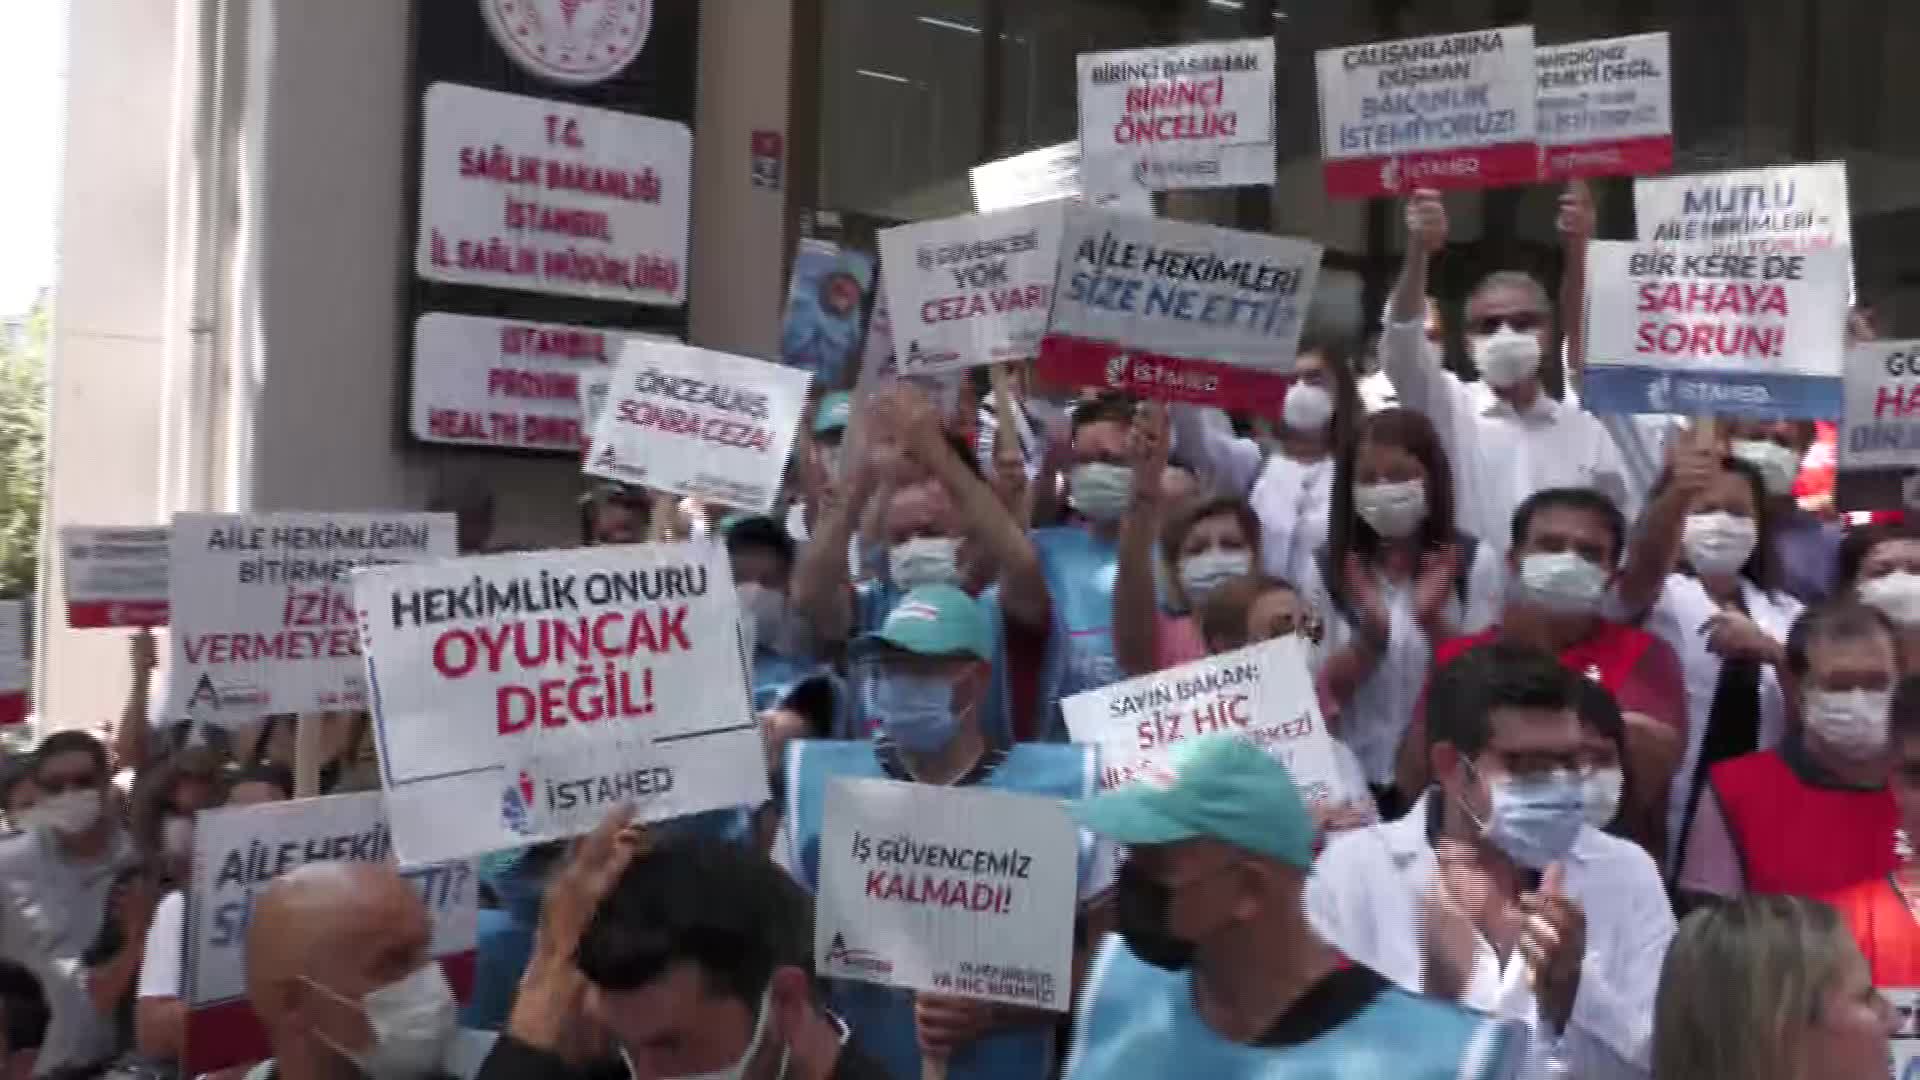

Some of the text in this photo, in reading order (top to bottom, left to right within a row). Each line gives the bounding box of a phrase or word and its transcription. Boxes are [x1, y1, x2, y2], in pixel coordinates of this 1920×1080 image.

[1091, 61, 1161, 86] BİRİNCİ
[1125, 75, 1223, 113] BİRİNCİ
[545, 115, 583, 148] T.C.
[1114, 111, 1237, 144] ÖNCELİK!
[458, 145, 660, 204] SAĞLIK BAKANLIĞI
[1684, 181, 1795, 215] MUTLU
[506, 198, 611, 241] İSTANBUL
[430, 227, 679, 294] İL SAĞLIK MÜDÜRLÜĞÜ
[953, 259, 1008, 288] YOK
[1074, 231, 1299, 295] AİLE HEKİMLERİ
[1629, 252, 1805, 280] BİR KERE DE
[921, 296, 986, 324] CEZA
[1071, 272, 1138, 313] SİZE
[1144, 282, 1195, 320] NE
[1636, 281, 1789, 316] SAHAYA
[1635, 322, 1787, 358] SORUN!
[488, 368, 577, 398] PROVIN
[635, 367, 704, 403] ÖNCE
[430, 407, 518, 444] HEALTH
[616, 399, 775, 453] SONRA CEZA!
[207, 519, 430, 552] AİLE HEKİMLİĞİNİ
[392, 564, 708, 629] HEKİMLİK ONURU
[433, 606, 691, 679] OYUNCAK
[496, 662, 656, 736] DEĞİL!
[1109, 687, 1172, 719] SAYIN
[1137, 692, 1249, 750] SİZ HİÇ
[547, 766, 675, 811] İSTAHED
[851, 831, 1033, 878] İŞ GÜVENCEMİZ
[865, 870, 1012, 914] KALMADI!
